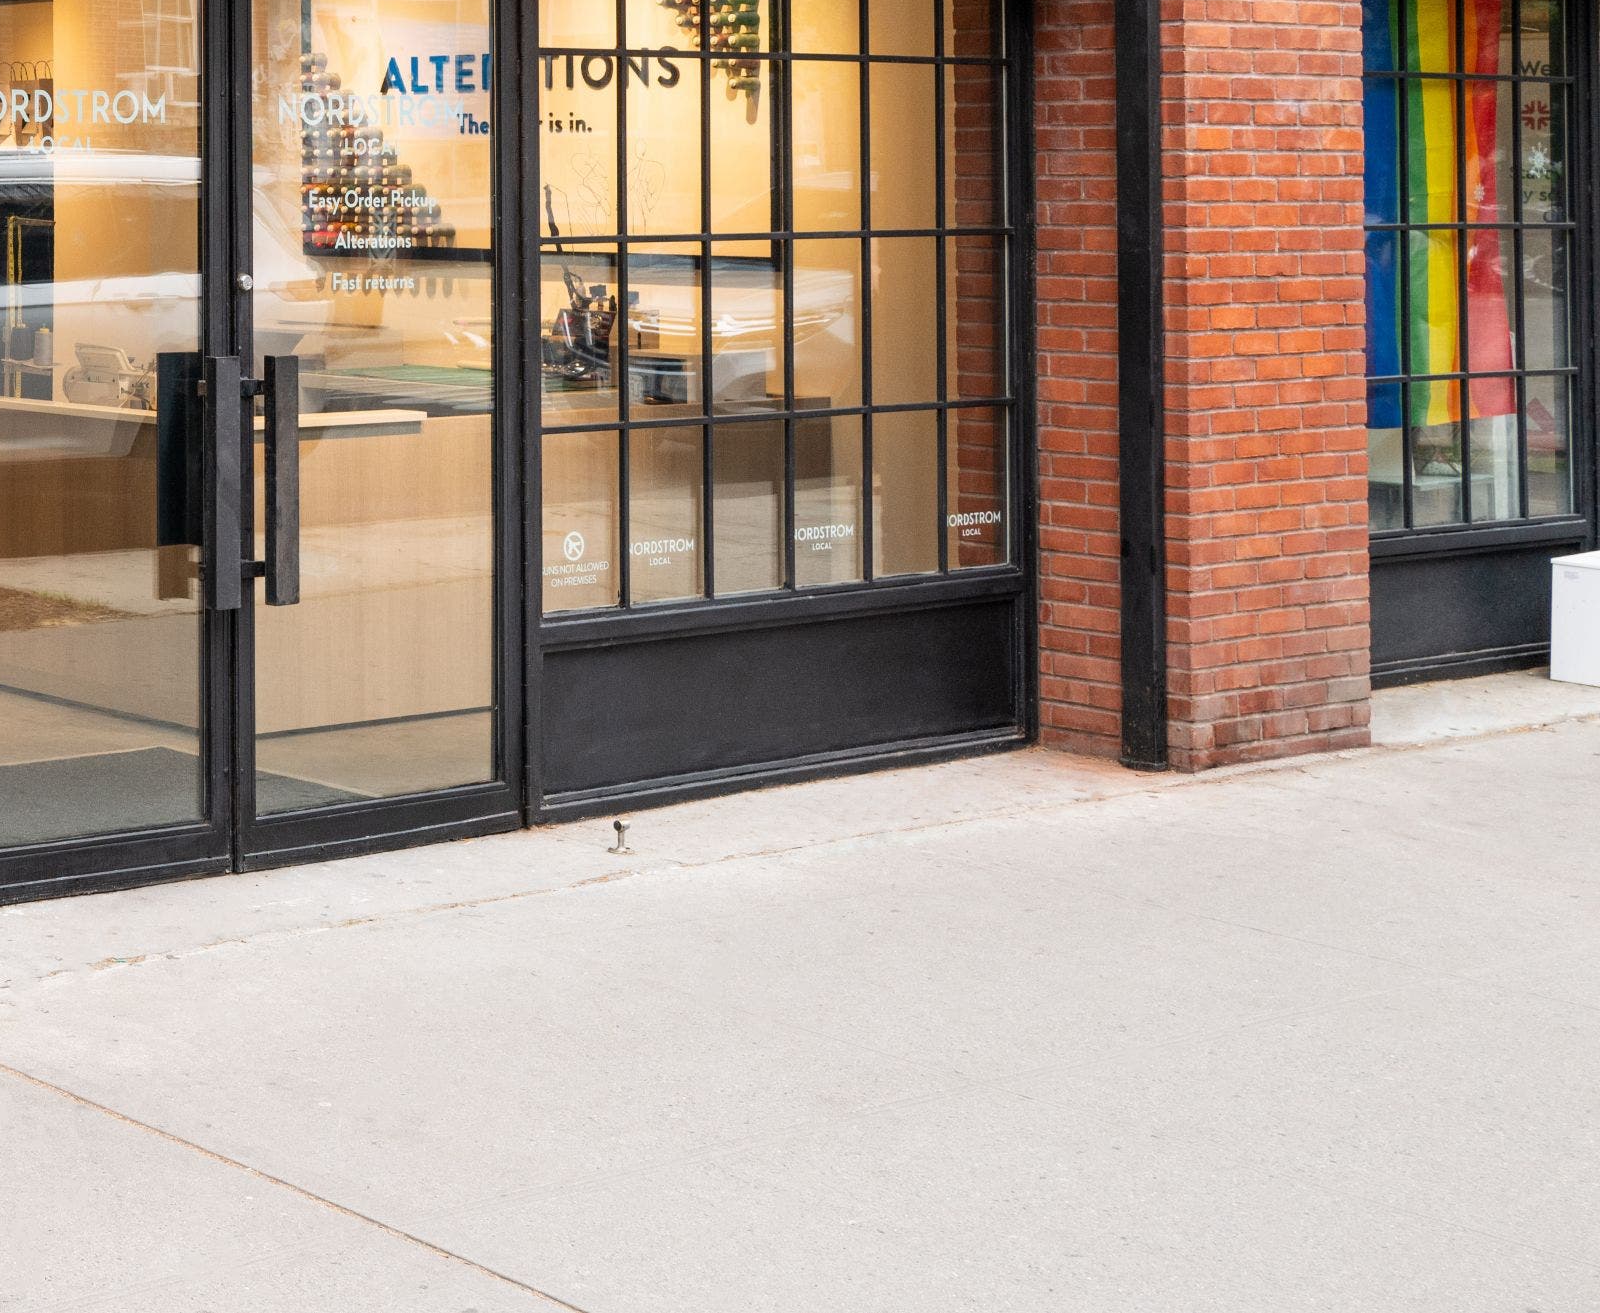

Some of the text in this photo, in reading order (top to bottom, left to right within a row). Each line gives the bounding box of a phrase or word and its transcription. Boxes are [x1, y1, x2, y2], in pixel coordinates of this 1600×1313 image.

[277, 91, 464, 128] NORDSTROM
[456, 112, 491, 135] The
[548, 112, 563, 133] is
[568, 112, 593, 133] in.
[29, 135, 96, 155] LOCAL
[308, 189, 438, 215] Easy Order Pickup
[334, 231, 413, 250] Alterations
[332, 272, 415, 290] Fast returns
[946, 510, 1001, 528] ORDSTROM
[962, 528, 982, 537] LOCAL
[812, 542, 833, 551] LOCAL
[560, 563, 575, 575] NOT
[576, 560, 609, 573] ALLOWED
[649, 556, 672, 566] LOCAL
[564, 574, 597, 587] PREMISES
